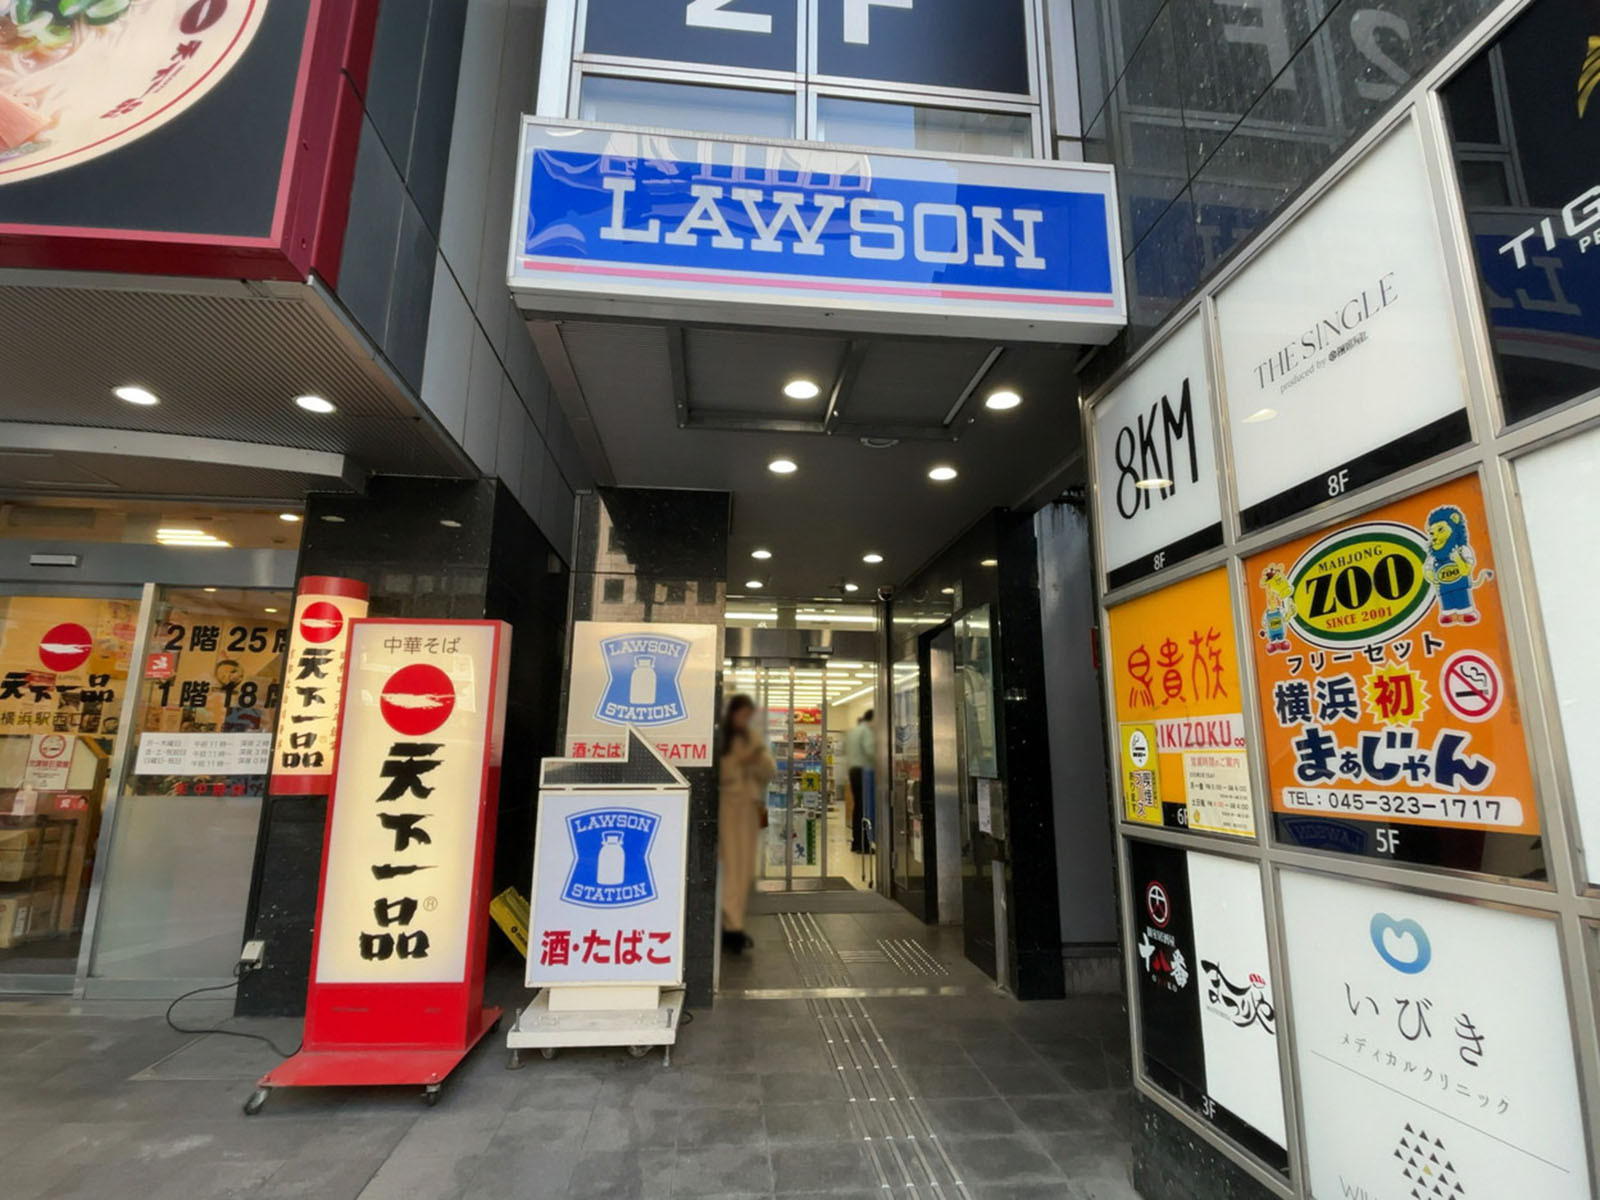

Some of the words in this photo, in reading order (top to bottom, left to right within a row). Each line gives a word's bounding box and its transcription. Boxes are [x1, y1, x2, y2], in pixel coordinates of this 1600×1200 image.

[600, 177, 1046, 270] LAWSON
[1253, 342, 1299, 389] THE
[1301, 271, 1398, 360] SINGLE
[1115, 377, 1198, 520] 8KM
[1327, 469, 1350, 497] 8F
[1153, 551, 1166, 571] 8F
[1318, 545, 1383, 573] MAHJONG
[1440, 568, 1460, 579] ZOO
[1305, 553, 1415, 619] ZOO
[1325, 613, 1357, 629] SINCE
[1361, 606, 1393, 622] 2001
[384, 637, 461, 654] 中華そば
[608, 638, 682, 658] LAWSON
[1287, 634, 1443, 674] フリーセット
[0, 672, 114, 702] 天下一品
[1275, 676, 1358, 724] 横浜
[1373, 674, 1415, 719] 初
[281, 648, 336, 768] 天下一品
[604, 702, 678, 720] STATION
[1296, 728, 1490, 787] まぁじゃん
[1288, 791, 1321, 807] TEL:
[1328, 792, 1501, 820] 045-323-1717
[575, 814, 651, 832] LAWSON
[359, 742, 447, 962] 天下一品
[1376, 828, 1400, 853] 5F
[571, 882, 647, 901] STATION
[540, 929, 672, 965] 酒・たばこ
[1344, 982, 1485, 1067] いびき
[1341, 1033, 1509, 1114] メディカルクリニック
[1201, 1094, 1217, 1119] 3F
